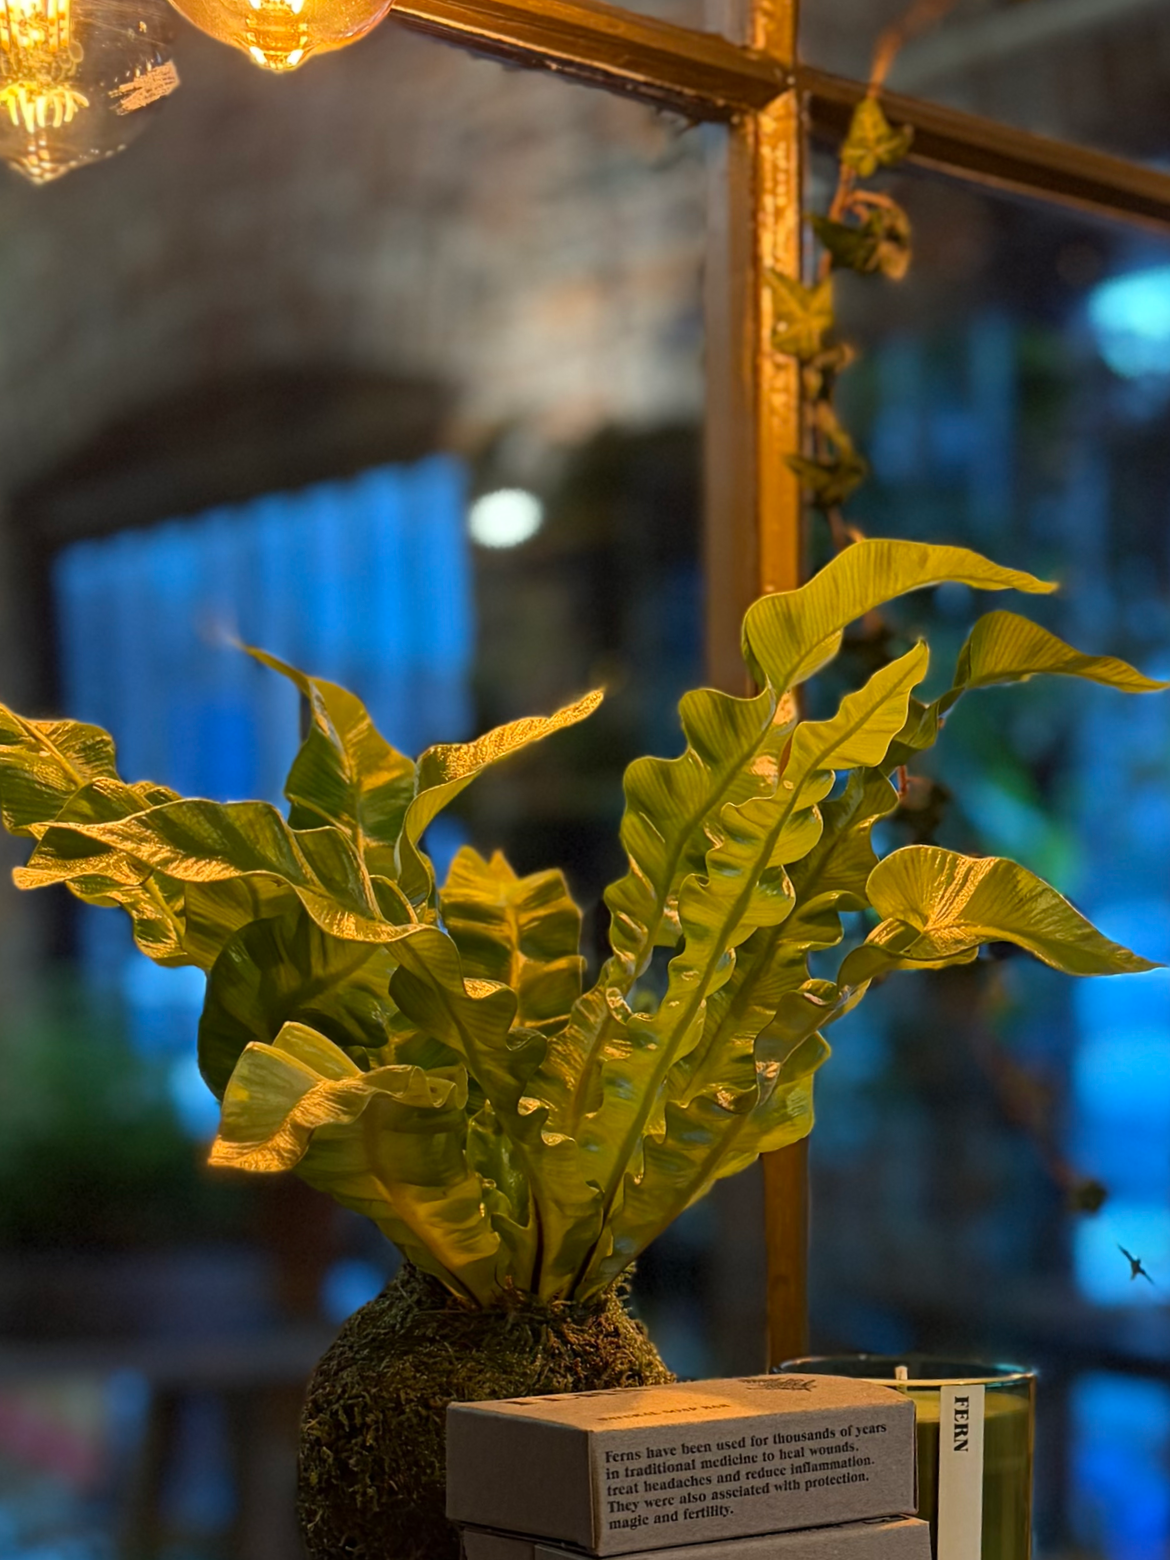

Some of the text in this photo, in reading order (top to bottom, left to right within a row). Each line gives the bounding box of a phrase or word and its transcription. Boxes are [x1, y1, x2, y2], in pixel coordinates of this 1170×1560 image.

[954, 1396, 969, 1452] FERN
[604, 1424, 887, 1464] Ferns have been used for thousands of years
[605, 1467, 620, 1480] in
[624, 1458, 696, 1478] traditional
[700, 1453, 758, 1469] medicine
[762, 1451, 775, 1462] to
[779, 1446, 805, 1460] heal
[607, 1455, 875, 1497] treat headaches and reduce inflammation.
[607, 1500, 640, 1514] They
[643, 1497, 675, 1508] were
[679, 1492, 707, 1504] also
[773, 1479, 800, 1492] with
[608, 1504, 734, 1531] magic and fertility.
